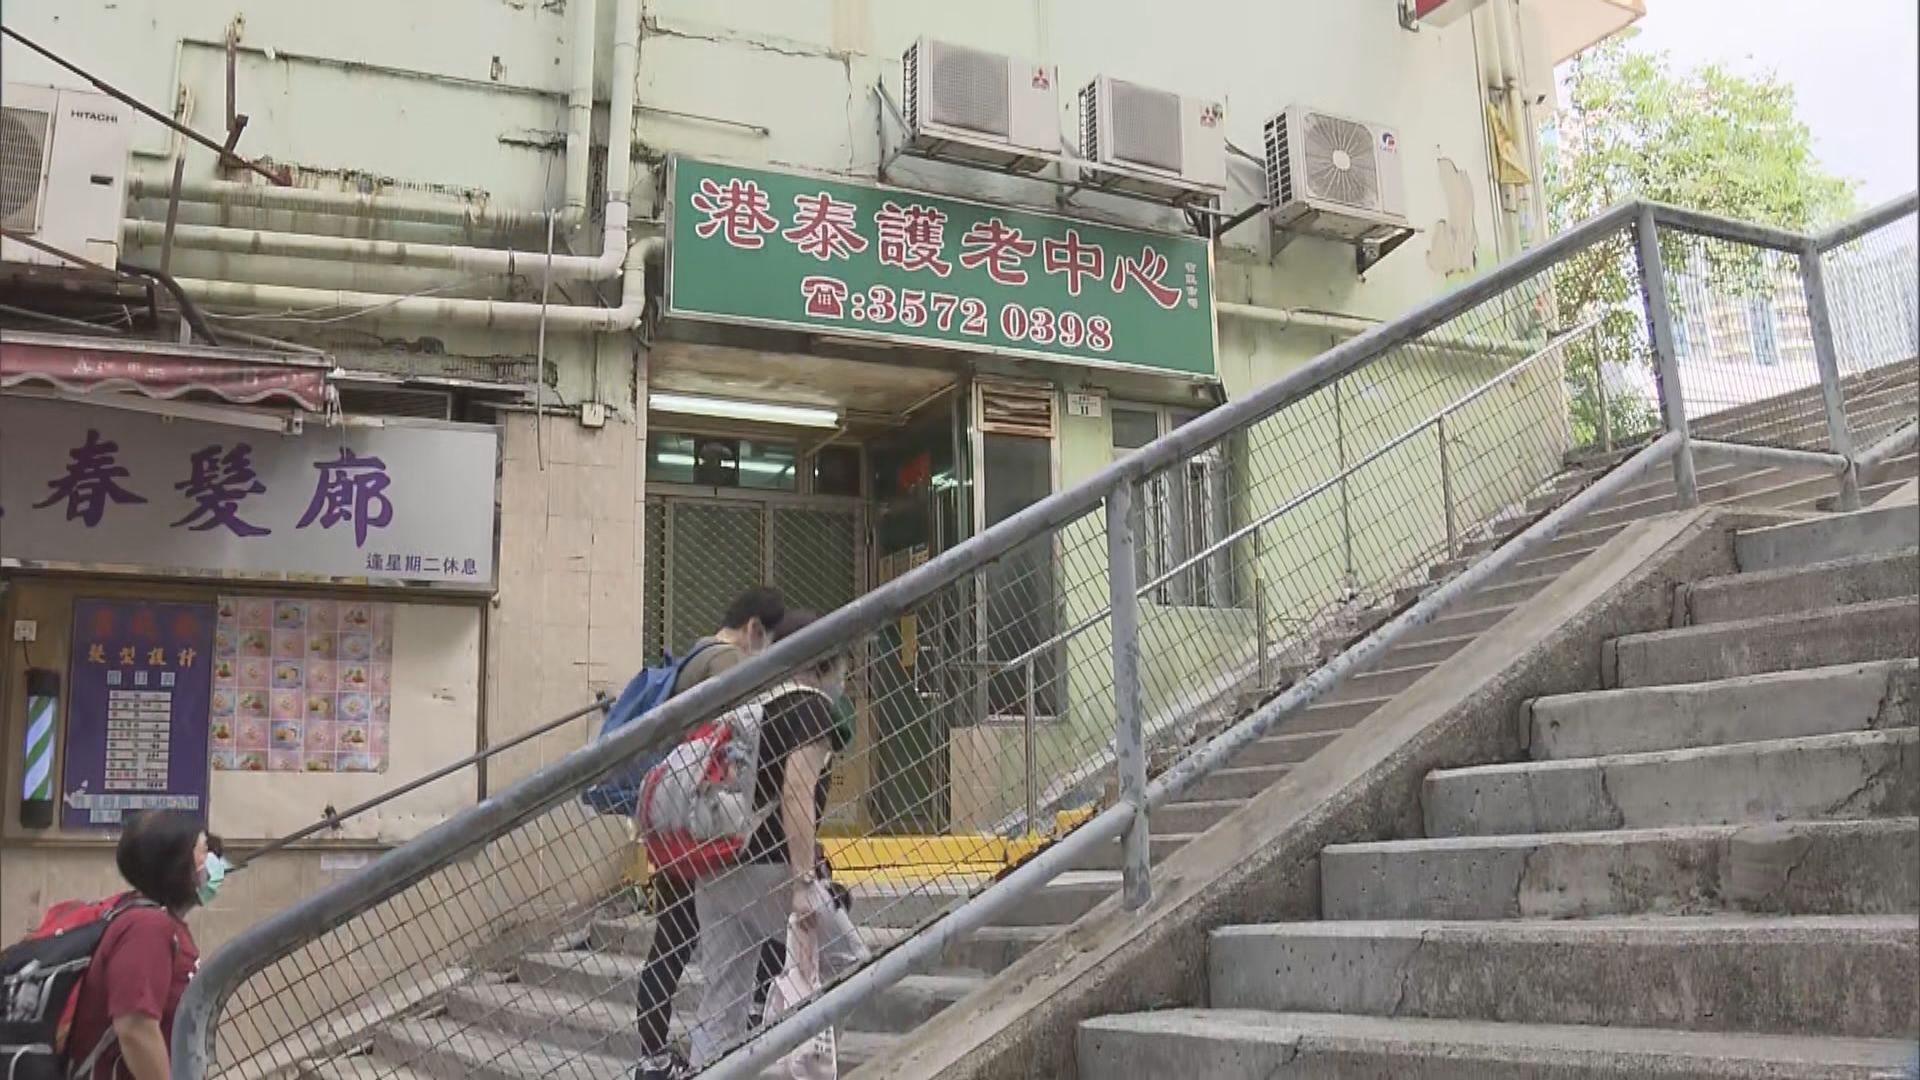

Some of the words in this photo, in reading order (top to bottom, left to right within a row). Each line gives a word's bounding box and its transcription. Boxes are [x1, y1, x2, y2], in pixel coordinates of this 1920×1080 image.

[71, 109, 118, 123] HITACHI
[691, 178, 1183, 309] 港泰護老中心
[1001, 304, 1113, 351] 0398
[0, 429, 394, 548] 春髮廊
[366, 552, 477, 575] 逢星期二休息
